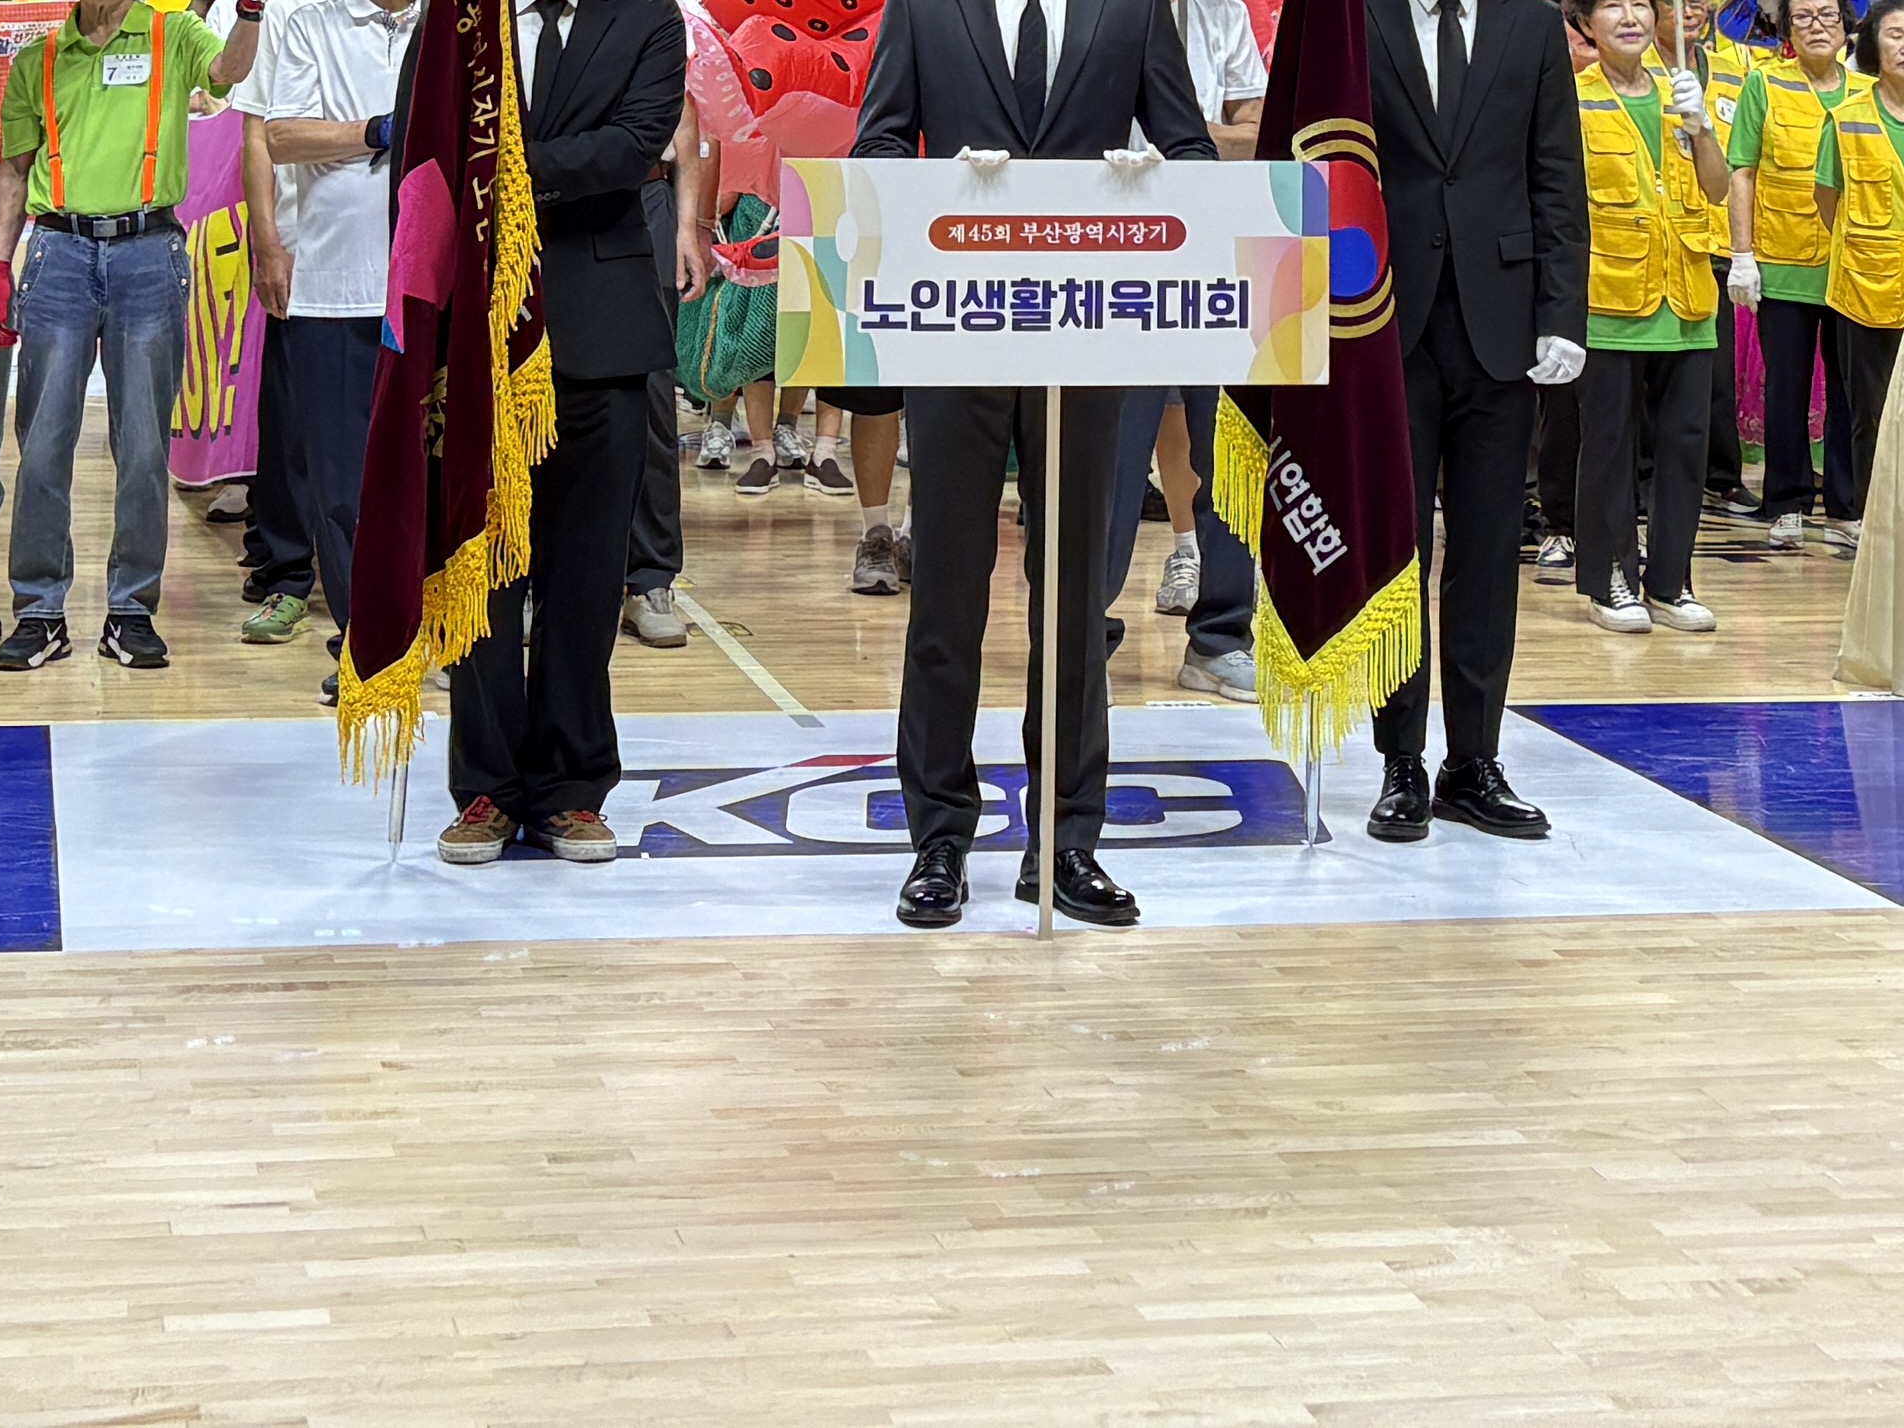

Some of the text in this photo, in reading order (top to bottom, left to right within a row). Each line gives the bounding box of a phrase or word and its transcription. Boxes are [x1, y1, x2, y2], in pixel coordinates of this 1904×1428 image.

[106, 66, 118, 81] 7
[947, 222, 1169, 245] 제45회 부산광역시장기
[860, 277, 1250, 332] 노인생활체육대회
